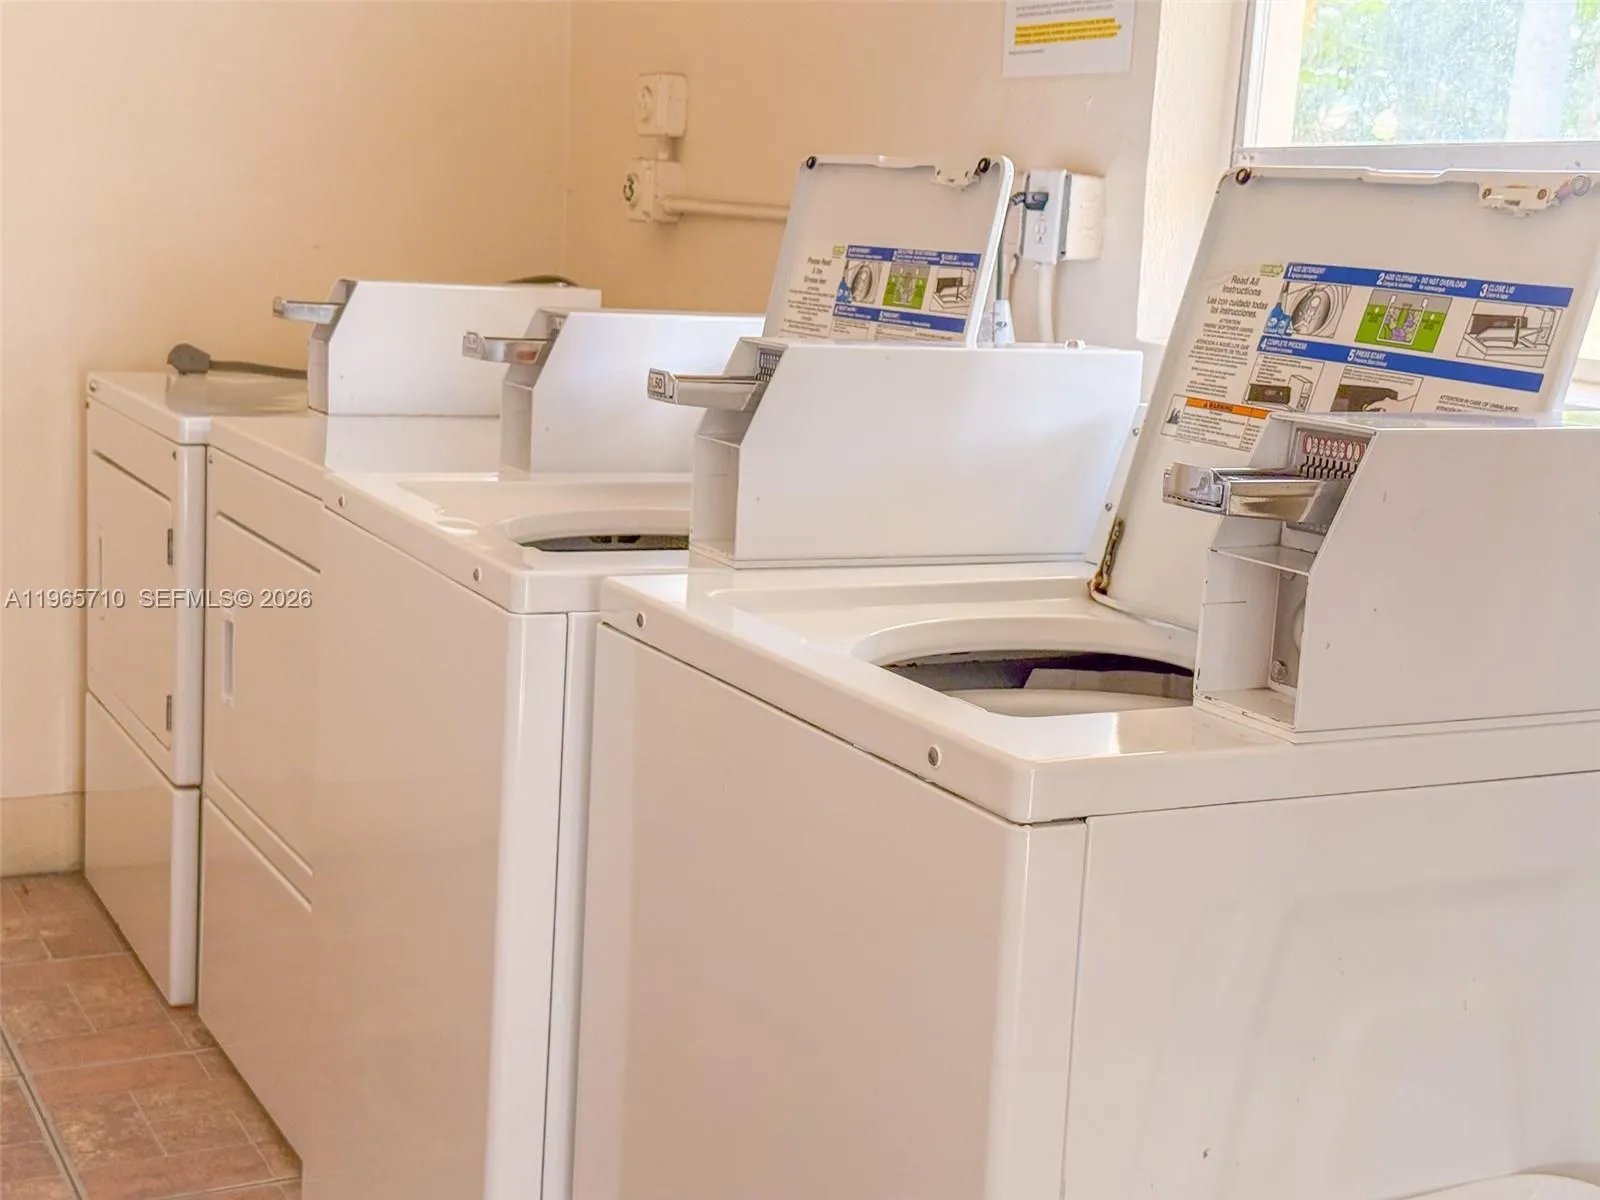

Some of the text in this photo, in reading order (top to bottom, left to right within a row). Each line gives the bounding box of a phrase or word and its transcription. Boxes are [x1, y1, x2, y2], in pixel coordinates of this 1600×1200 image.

[1230, 275, 1260, 286] Read All
[1376, 272, 1385, 286] 2
[1440, 279, 1467, 289] OVERLOAD
[1222, 285, 1262, 296] Instructions
[1480, 283, 1488, 297] 3
[1489, 284, 1505, 293] CLOSE
[1505, 286, 1516, 294] LID
[1260, 338, 1267, 350] 4
[1347, 349, 1356, 361] 5
